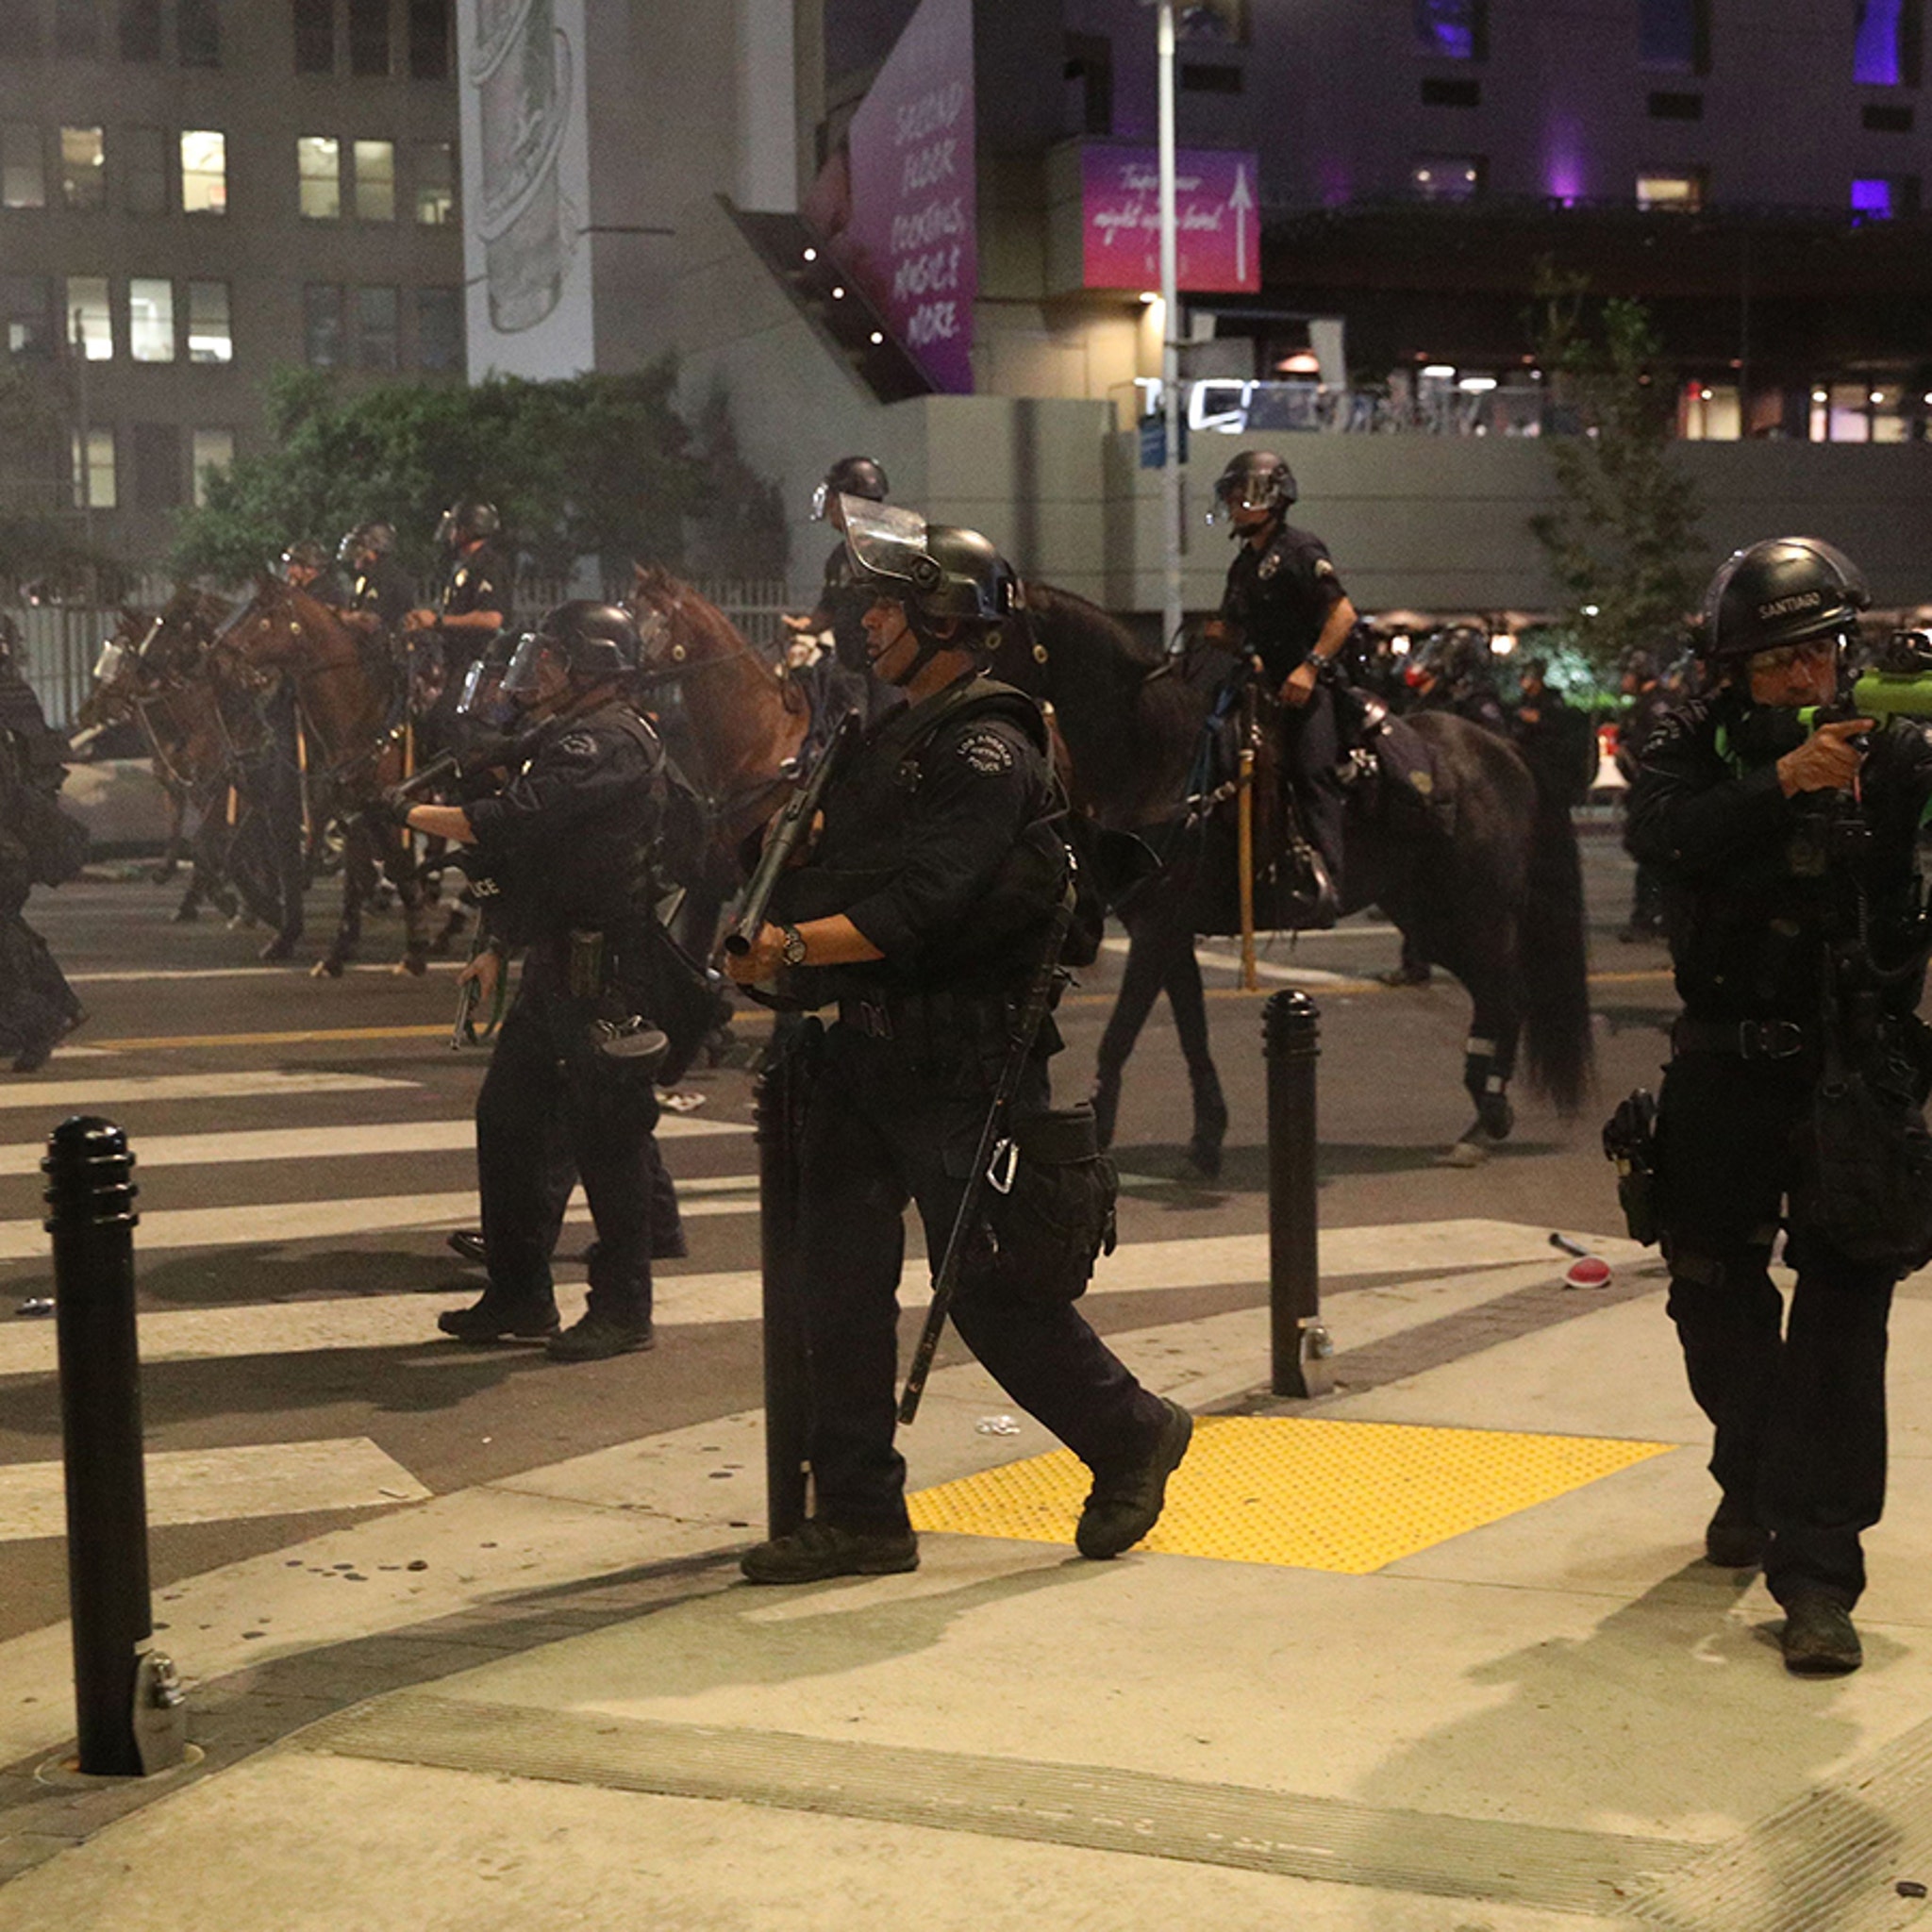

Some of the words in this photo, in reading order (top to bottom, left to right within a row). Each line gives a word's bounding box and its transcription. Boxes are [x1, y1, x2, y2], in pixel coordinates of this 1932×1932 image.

[902, 139, 957, 196] FLOOR
[1757, 591, 1821, 620] SANTIAGO
[956, 738, 975, 755] LOS
[976, 734, 1012, 767] ANGELES
[967, 755, 1000, 772] POLICE
